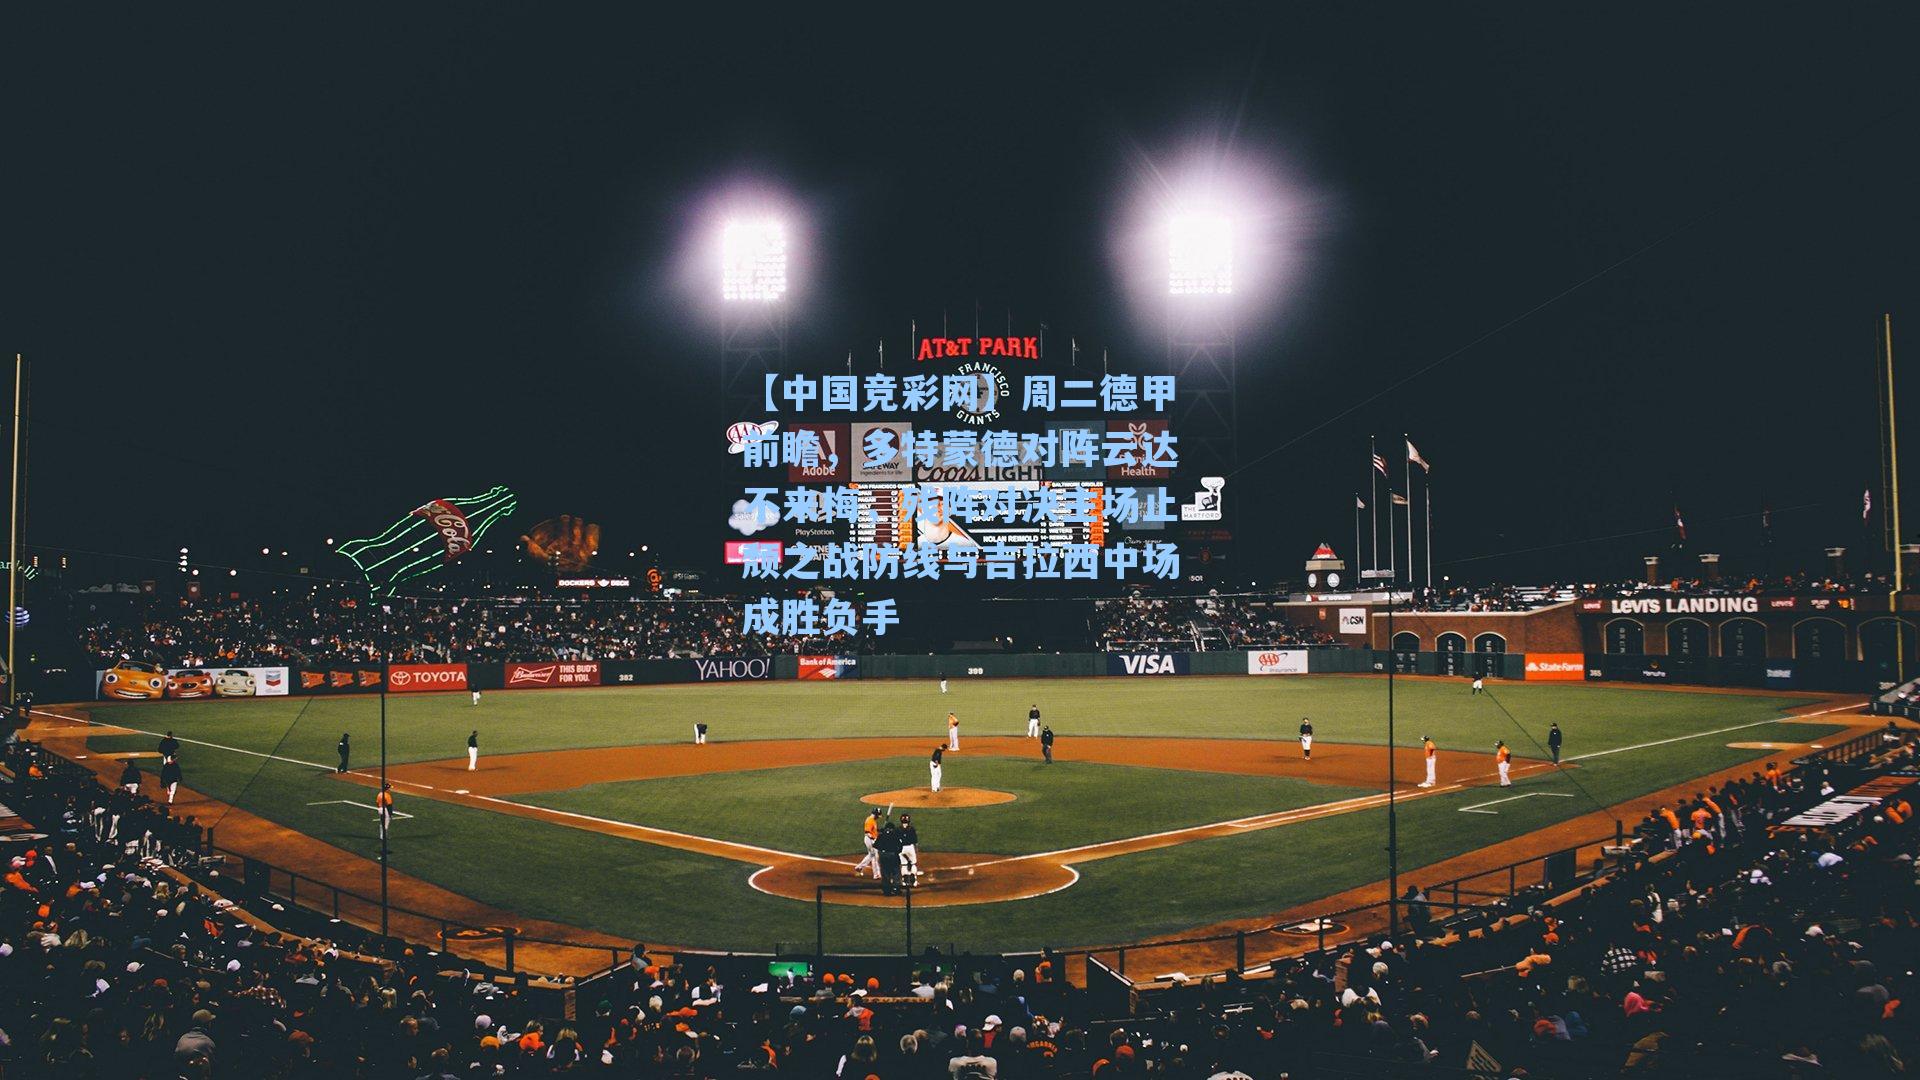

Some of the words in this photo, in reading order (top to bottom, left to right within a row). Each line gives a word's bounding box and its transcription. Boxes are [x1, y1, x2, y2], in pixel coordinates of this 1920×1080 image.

[917, 338, 972, 360] AT&T
[979, 336, 1038, 359] PARK
[958, 361, 1010, 397] FRANCISCO
[956, 408, 1000, 425] GIANTS
[802, 464, 835, 476] Adobe
[1121, 467, 1156, 476] Health
[795, 529, 834, 537] PlayStation
[1666, 597, 1759, 613] LANDING
[1350, 616, 1364, 625] CSN
[818, 658, 827, 666] of
[1119, 655, 1175, 674] VISA
[559, 665, 575, 673] THIS
[576, 664, 598, 673] BUD'S
[695, 658, 770, 680] YAHOO!
[413, 671, 467, 683] TOYOTA
[559, 674, 573, 683] FOR
[574, 674, 590, 682] YOU.
